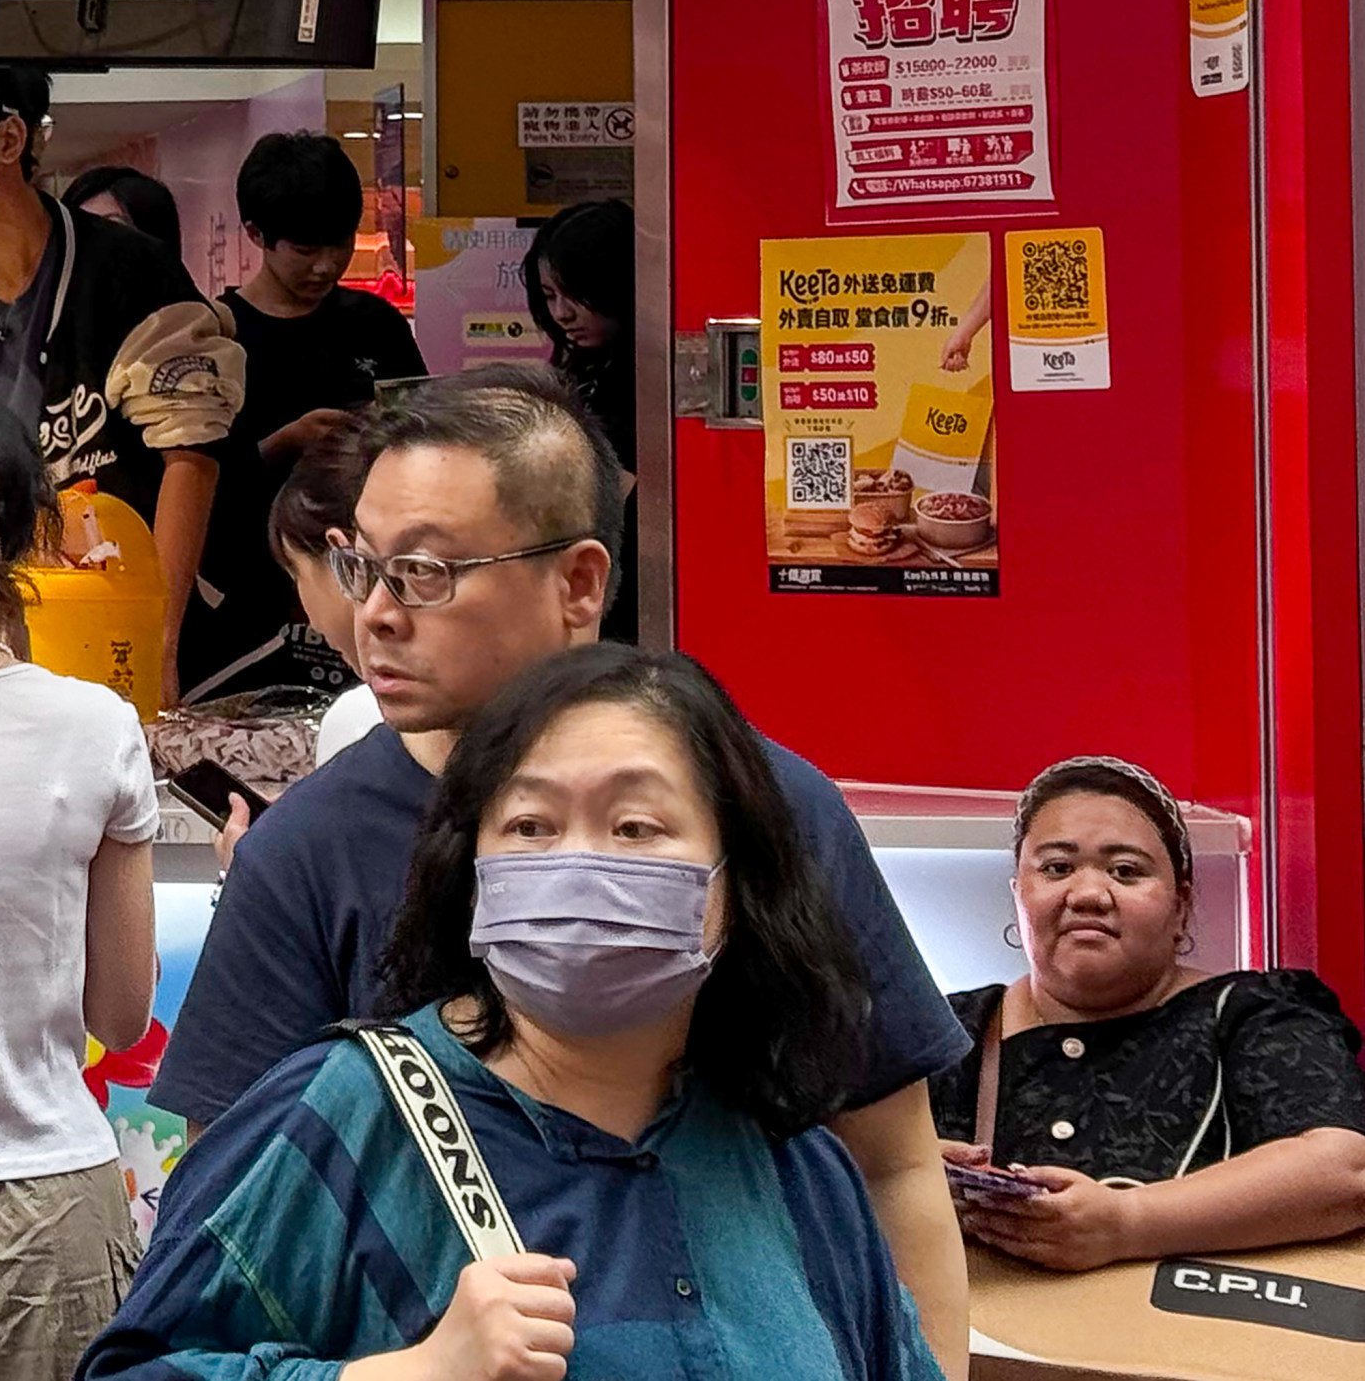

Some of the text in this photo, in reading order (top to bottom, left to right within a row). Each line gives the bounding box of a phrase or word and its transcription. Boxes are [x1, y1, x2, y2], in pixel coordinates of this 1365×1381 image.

[895, 55, 998, 75] $15000-22000
[524, 133, 601, 145] Pets No Entry
[843, 271, 936, 294] 外送免運費
[778, 307, 850, 330] 外賣自取
[1174, 1268, 1308, 1309] C.P.U.
